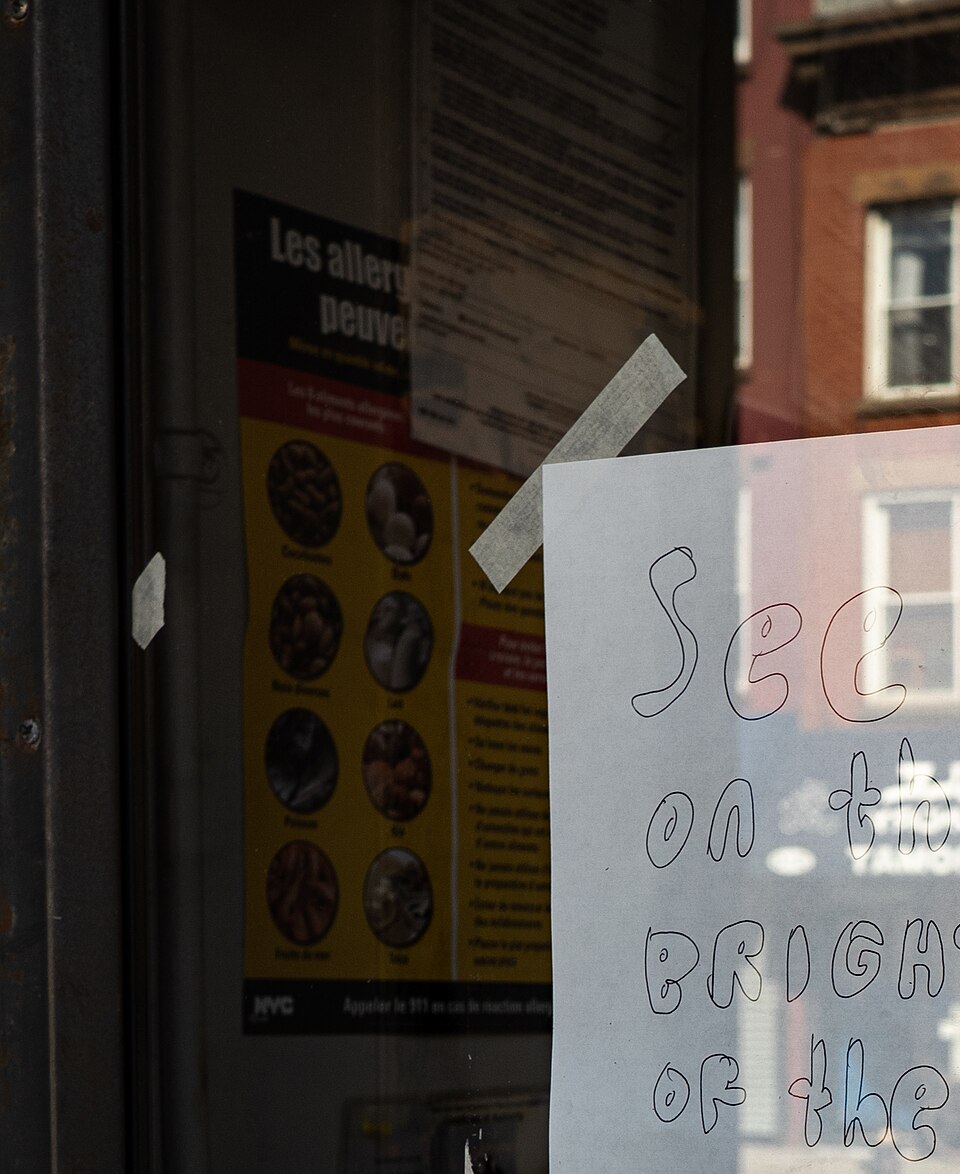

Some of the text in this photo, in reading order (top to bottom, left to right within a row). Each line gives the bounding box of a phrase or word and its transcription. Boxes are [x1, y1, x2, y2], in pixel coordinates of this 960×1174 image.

[268, 215, 323, 273] Les
[631, 546, 907, 723] See
[646, 778, 756, 869] on
[253, 995, 294, 1015] NYC
[653, 1053, 747, 1134] OF
[788, 1034, 950, 1161] the
